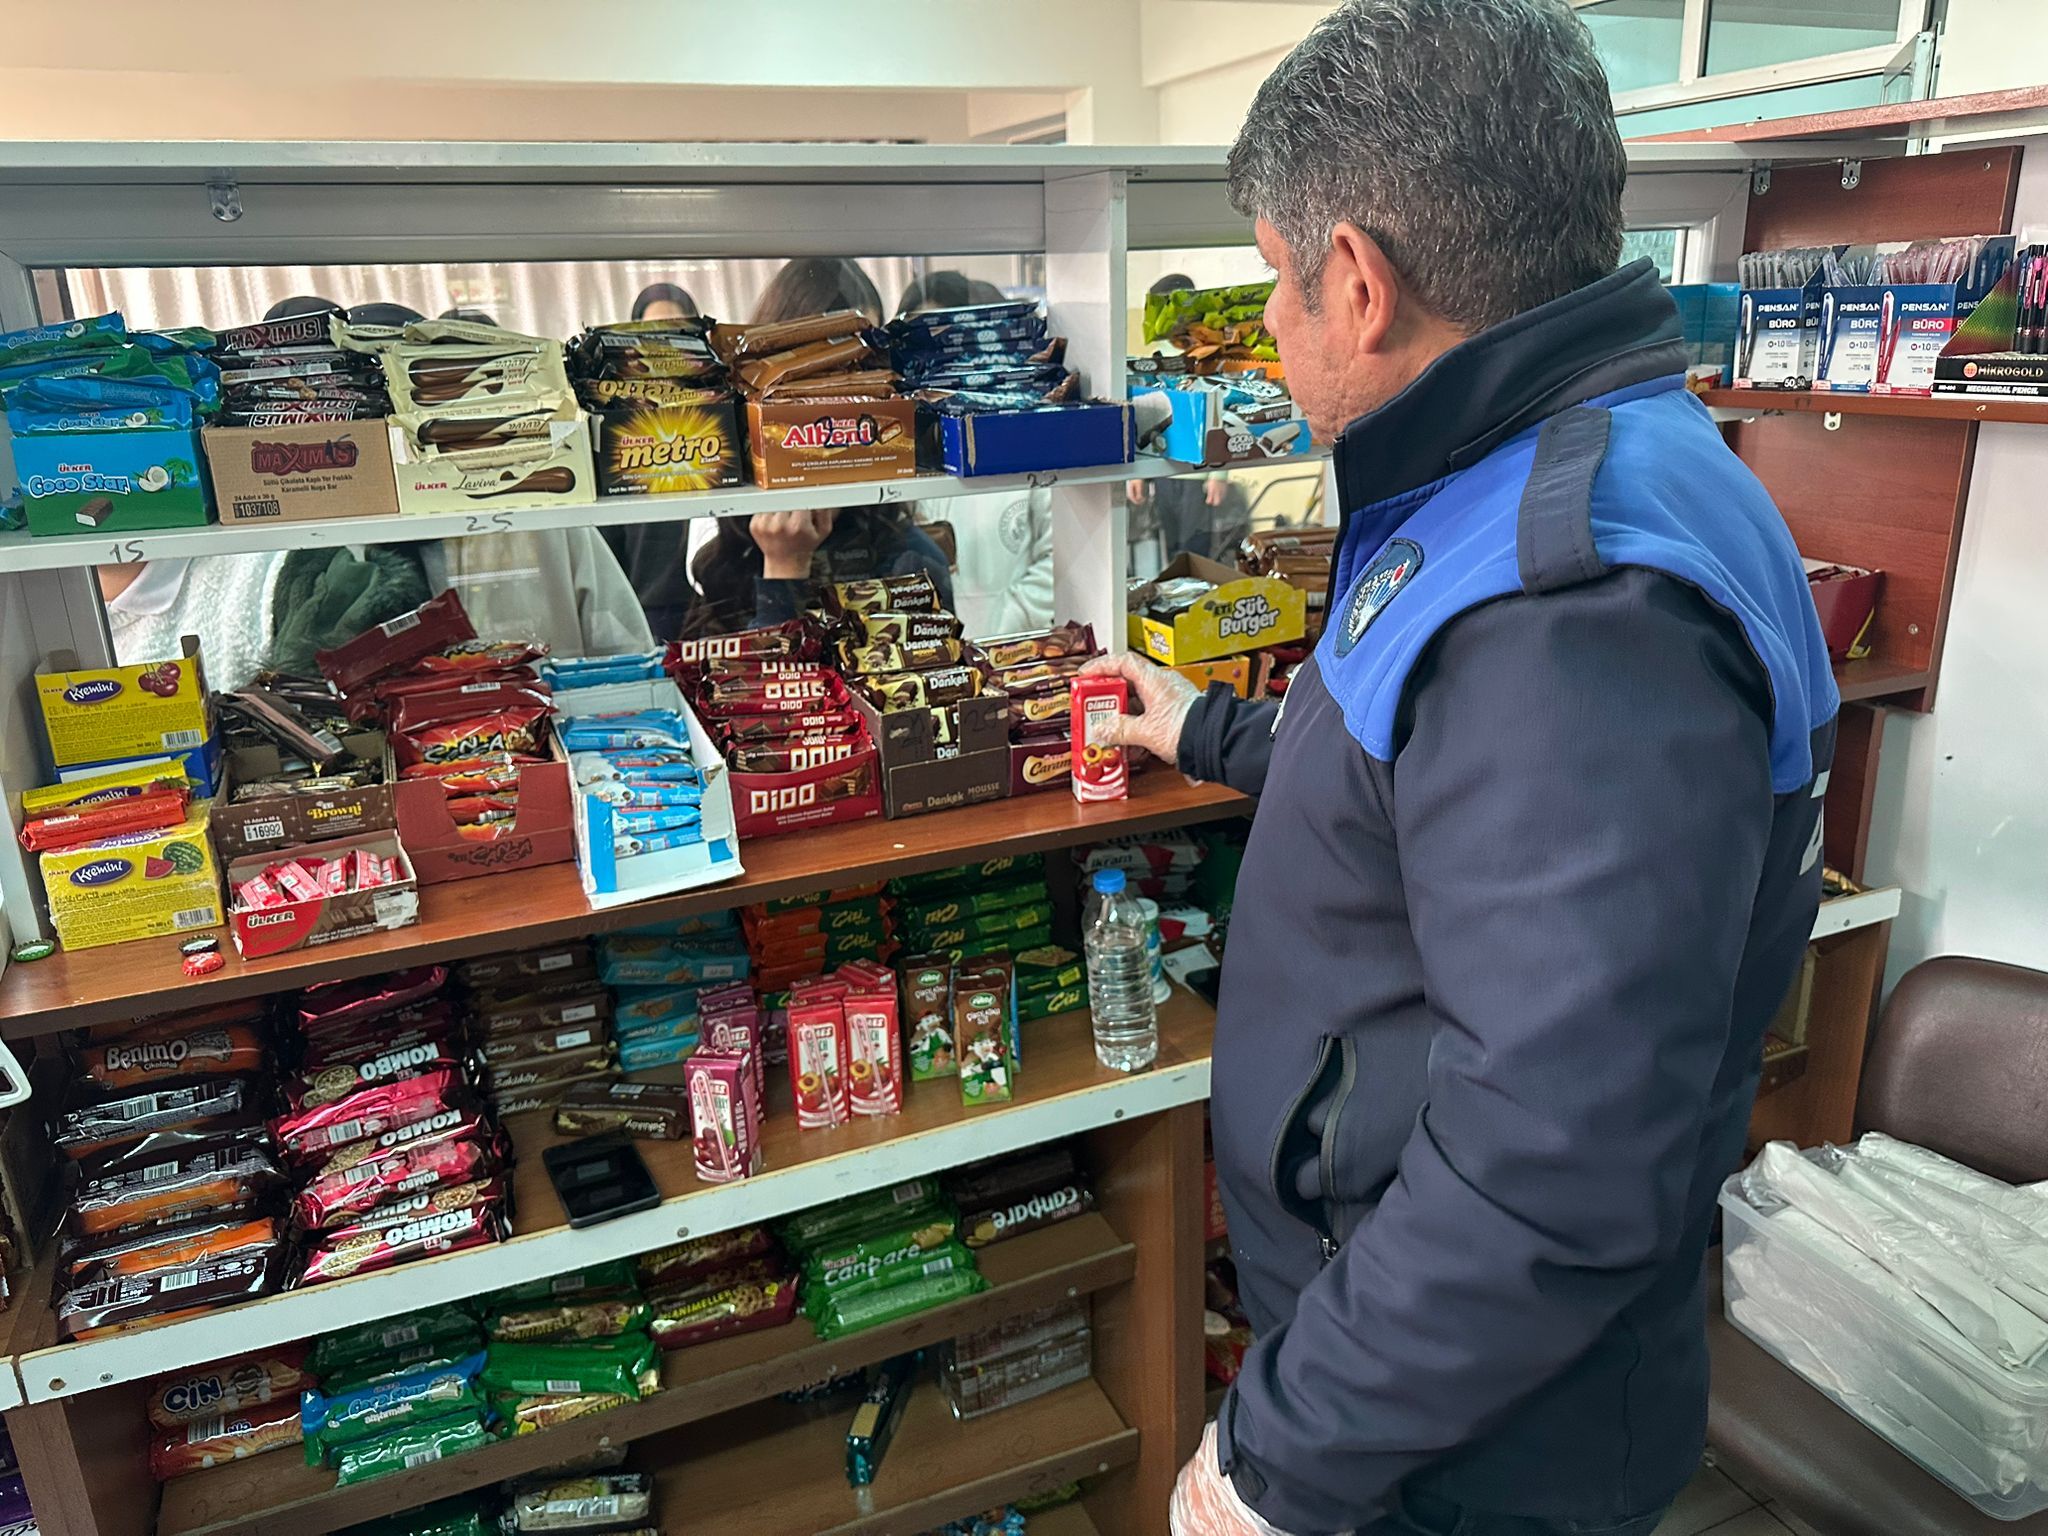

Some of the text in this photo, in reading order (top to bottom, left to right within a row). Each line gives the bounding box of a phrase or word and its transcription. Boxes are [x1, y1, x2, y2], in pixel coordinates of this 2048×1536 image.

[1758, 303, 1798, 313] PENSAN
[1839, 303, 1881, 312] PENSAN
[1901, 303, 1947, 312] PENSAN
[1769, 317, 1797, 329] BÜRO
[1805, 317, 1818, 327] BÜ
[1912, 319, 1945, 330] BÜRO
[231, 320, 319, 349] MAXIMUS
[781, 421, 871, 449] Albeni
[619, 434, 721, 470] metro
[57, 462, 93, 474] ÜLKER
[28, 472, 131, 499] Coco Star
[414, 474, 499, 491] ÜLKER Laviva
[239, 500, 280, 518] 1037108
[465, 512, 514, 533] 25
[109, 539, 145, 563] 15
[1233, 595, 1268, 620] Süt
[913, 624, 950, 637] Dankek
[1219, 609, 1280, 637] Burger
[929, 673, 969, 689] Dankek
[68, 682, 115, 701] Kremini
[967, 782, 1000, 795] MOUSSE
[927, 792, 965, 808] Dankek
[306, 801, 363, 821] Browni
[252, 823, 283, 839] 16992
[76, 861, 123, 883] Kremini
[248, 911, 295, 928] ÜLKER
[359, 1042, 440, 1082] KOMBO
[380, 1109, 463, 1147] KOMBO
[397, 1171, 440, 1192] KOMBO
[385, 1208, 473, 1247] KOMBO
[824, 1243, 921, 1286] canpare
[163, 1376, 223, 1413] CiN
